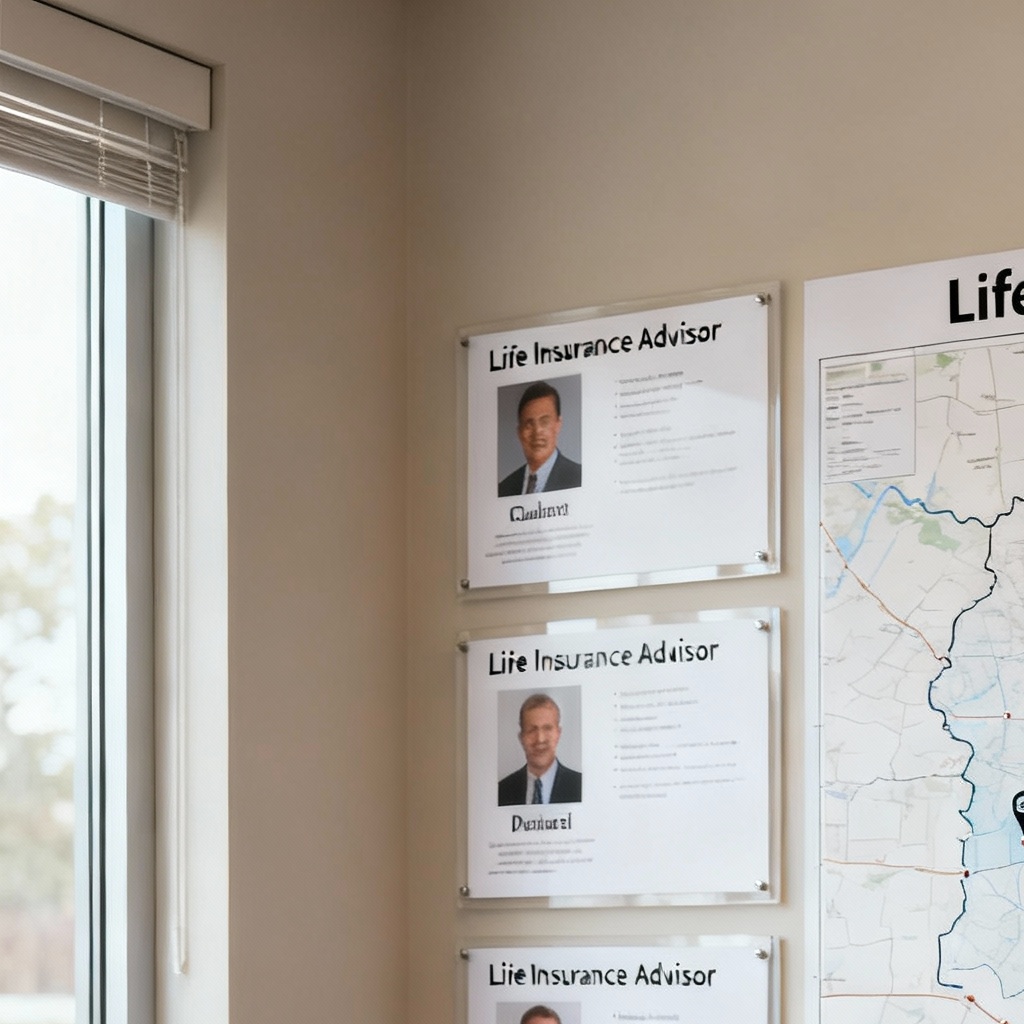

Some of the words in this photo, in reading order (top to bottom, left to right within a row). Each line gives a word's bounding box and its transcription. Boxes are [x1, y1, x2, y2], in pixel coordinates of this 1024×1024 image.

[534, 335, 632, 365] Insurance
[638, 321, 721, 350] Advisor
[638, 638, 719, 664] Advisor
[531, 964, 627, 986] Insurance
[635, 962, 716, 986] Advisor
